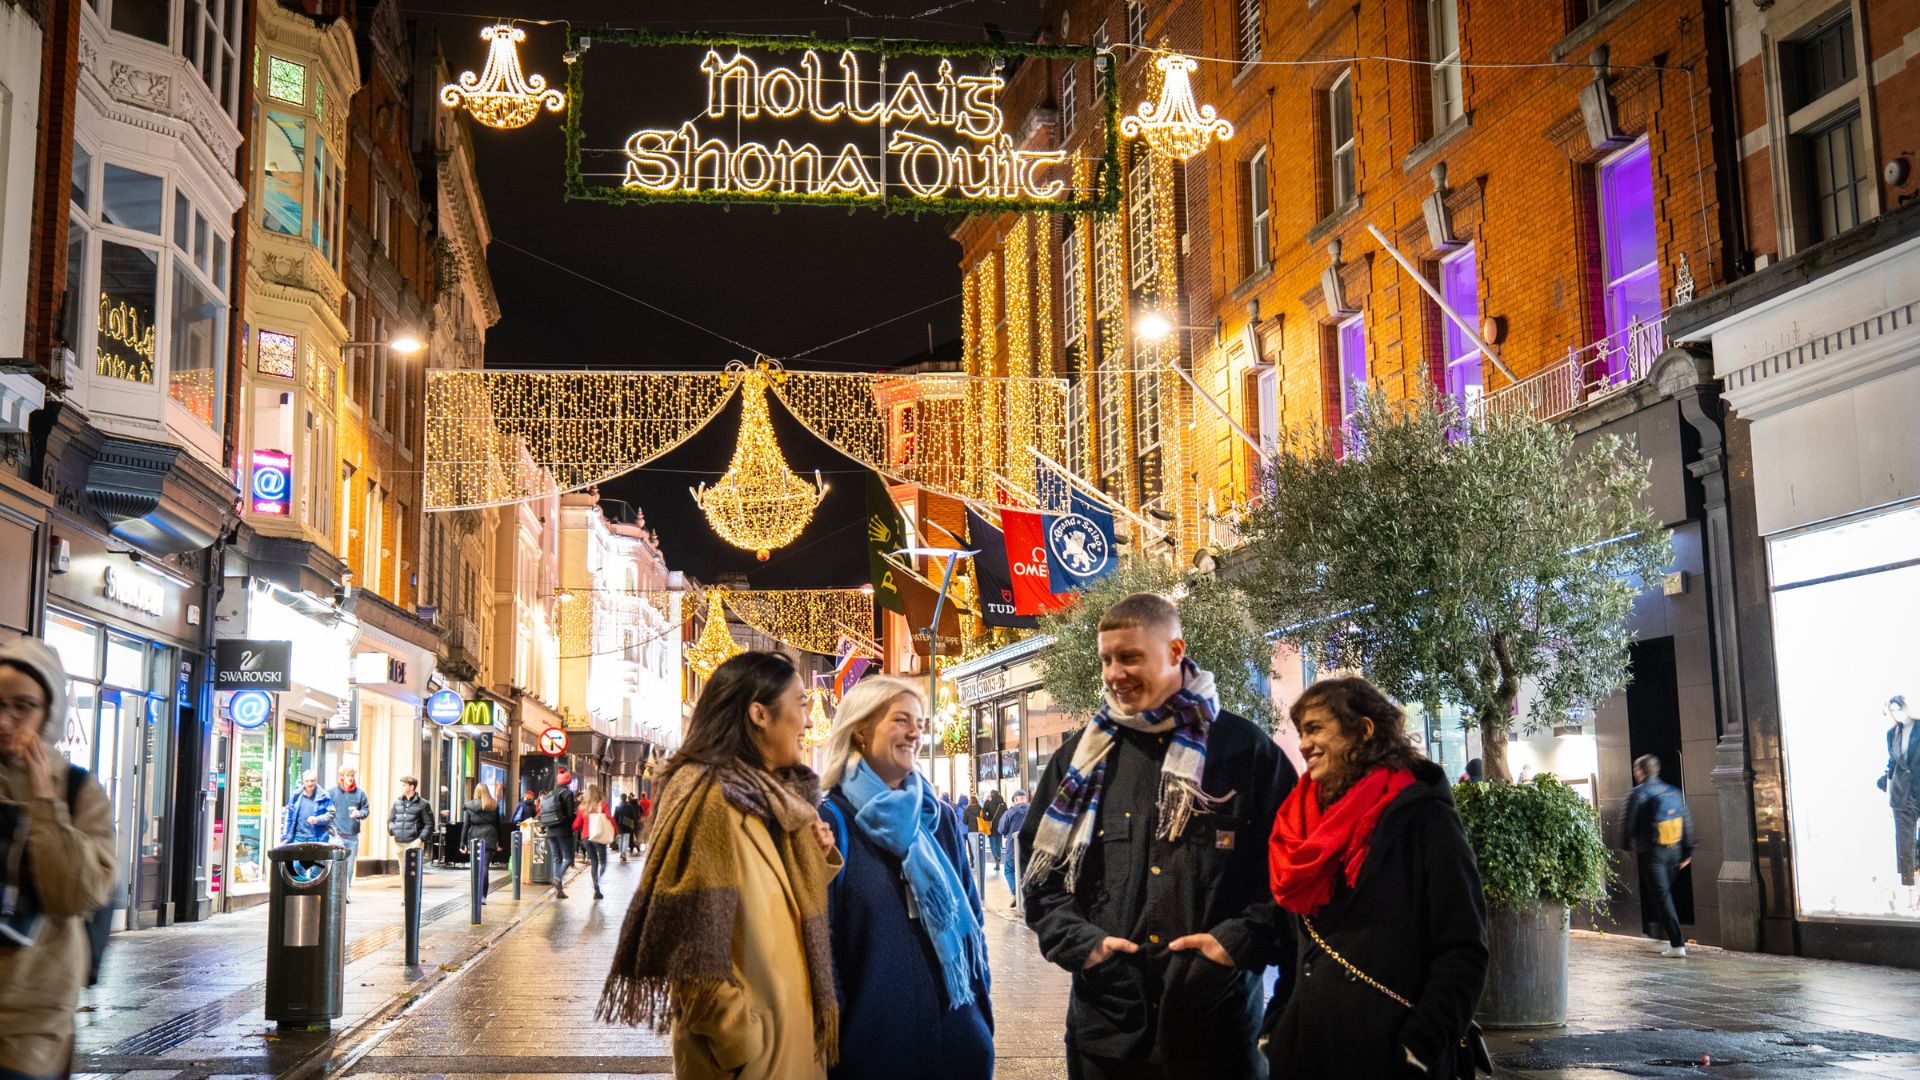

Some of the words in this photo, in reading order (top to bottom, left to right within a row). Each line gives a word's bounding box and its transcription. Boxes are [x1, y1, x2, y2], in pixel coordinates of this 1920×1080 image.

[1013, 562, 1049, 578] OME
[988, 603, 1016, 614] TUD
[219, 670, 282, 683] SWAROVSKI
